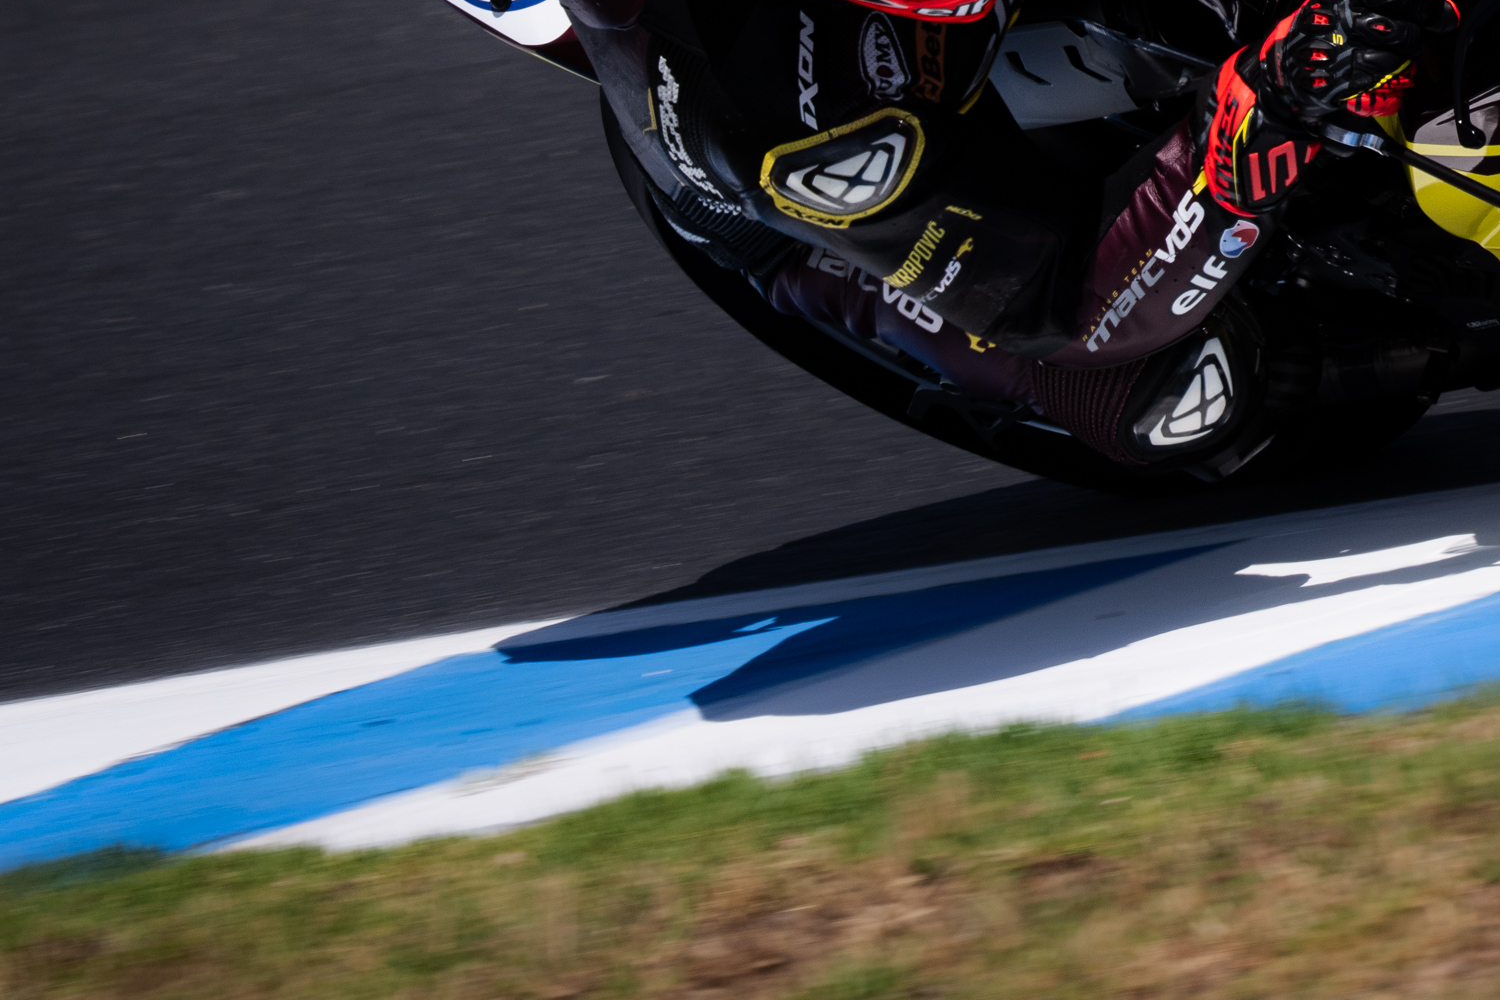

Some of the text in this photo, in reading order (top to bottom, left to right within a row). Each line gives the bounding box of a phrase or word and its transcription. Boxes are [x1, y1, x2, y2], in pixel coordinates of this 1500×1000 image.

[875, 22, 895, 95] UOMY
[921, 20, 943, 80] Bet
[1123, 247, 1154, 283] TEAM
